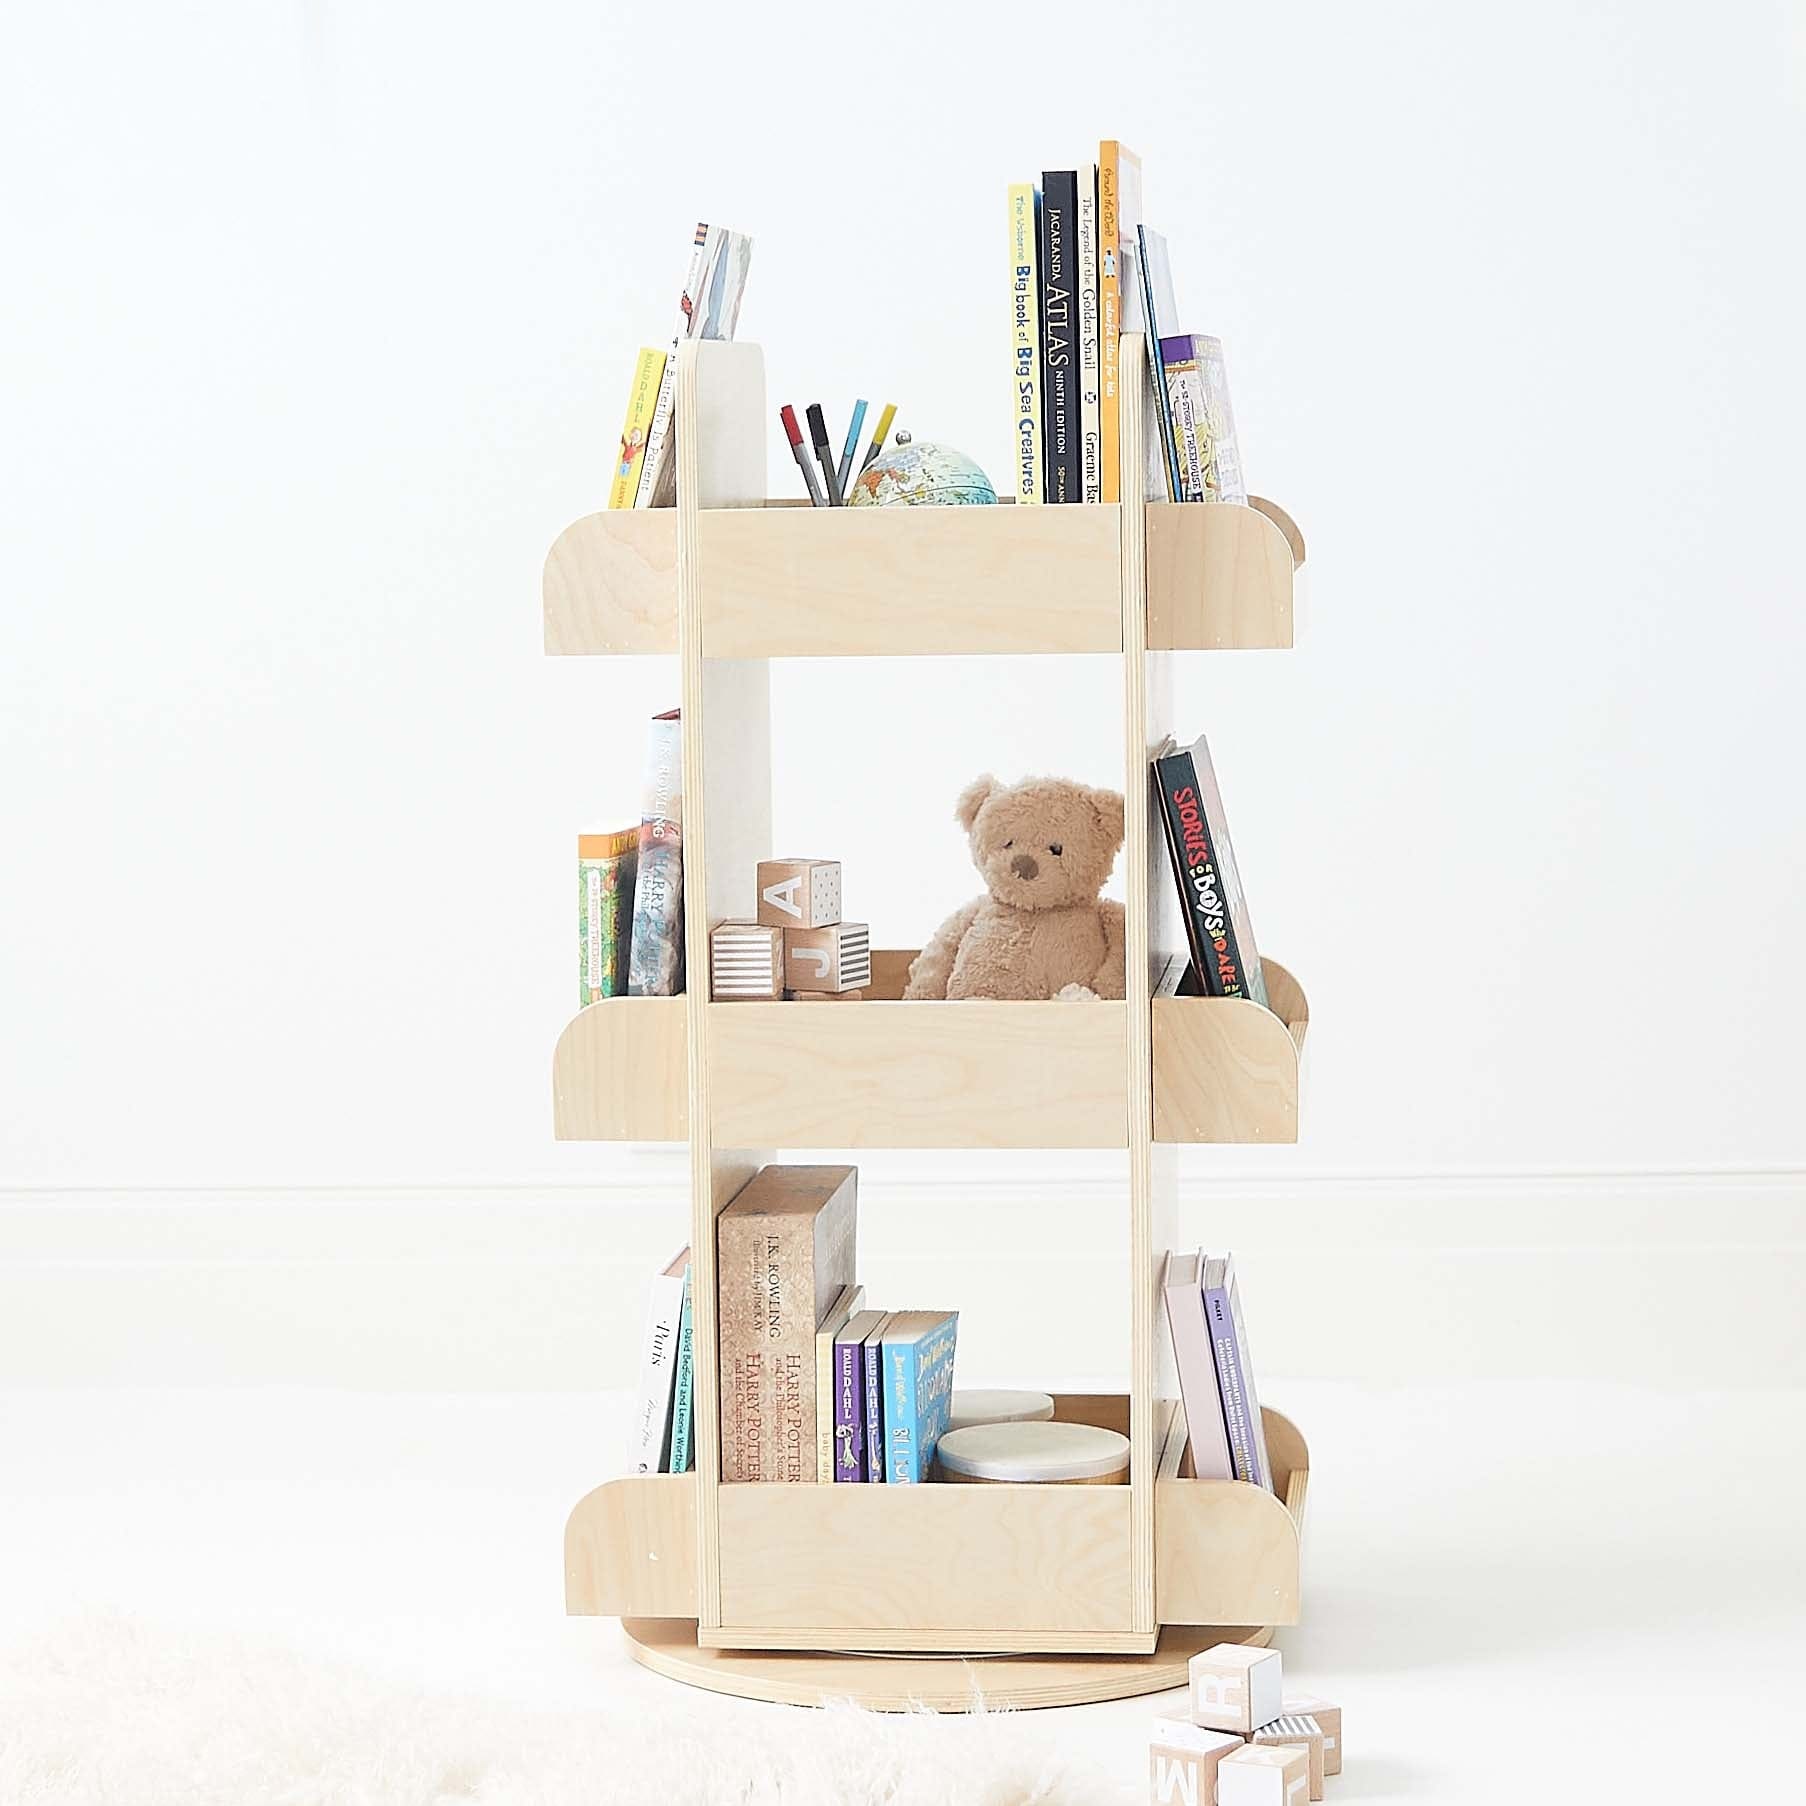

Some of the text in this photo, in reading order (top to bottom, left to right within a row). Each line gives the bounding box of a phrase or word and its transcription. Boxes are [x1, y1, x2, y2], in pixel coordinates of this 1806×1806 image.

[1048, 208, 1061, 281] JACARANDA
[1015, 265, 1031, 291] Big
[1080, 197, 1097, 370] The Legend of the Golden Snail
[1015, 294, 1031, 329] book
[1046, 282, 1071, 368] ATLAS
[1018, 331, 1029, 342] of
[1016, 347, 1033, 376] Big
[1019, 381, 1034, 413] Sea
[1055, 370, 1065, 406] NINTH
[1056, 410, 1066, 454] EDITION
[1018, 418, 1035, 496] Creatures
[1085, 431, 1098, 481] Graeme
[1186, 432, 1202, 490] TREEHOUSE
[653, 766, 671, 839] ROWLING
[1173, 786, 1210, 867] STORIES
[649, 850, 671, 914] HARRY
[763, 875, 802, 919] A
[1193, 872, 1225, 931] BOYS
[791, 947, 831, 978] J
[1213, 938, 1237, 985] DARE
[766, 1236, 781, 1338] J.K. ROWLING
[651, 1324, 671, 1367] Paris
[683, 1328, 693, 1351] David
[678, 1389, 688, 1406] and
[843, 1348, 852, 1419] ROALD DAHL
[869, 1377, 879, 1419] DAHL
[735, 1393, 746, 1436] Chamber
[746, 1352, 762, 1482] HARRY POTTER
[786, 1354, 802, 1482] HARRY POTTER
[821, 1432, 831, 1461] baby
[1198, 1672, 1242, 1717] R
